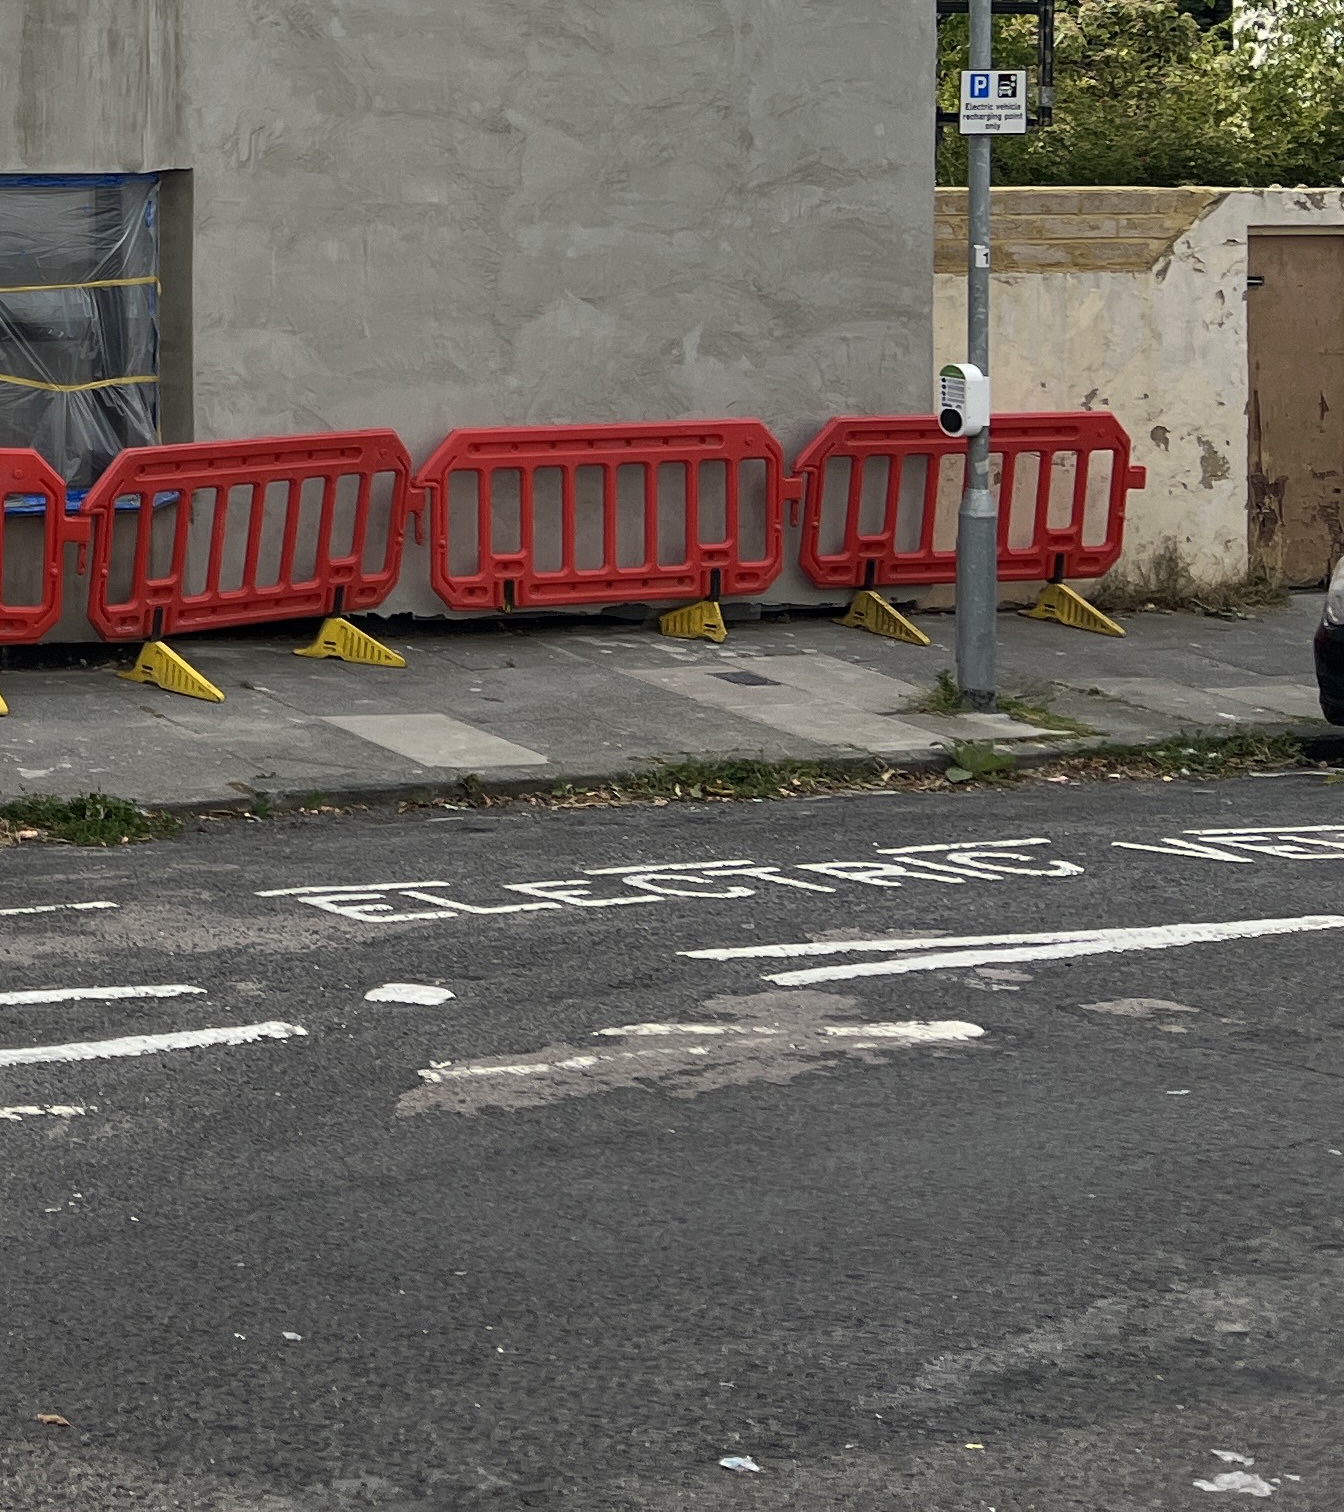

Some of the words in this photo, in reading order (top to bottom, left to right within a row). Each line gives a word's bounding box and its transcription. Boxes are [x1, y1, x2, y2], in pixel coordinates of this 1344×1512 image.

[974, 75, 987, 96] P
[965, 102, 994, 110] Electric
[996, 102, 1021, 110] vehicle
[962, 113, 1002, 121] recharging
[1004, 112, 1023, 121] point
[985, 122, 1001, 131] only
[298, 850, 1085, 923] ELECTRIC
